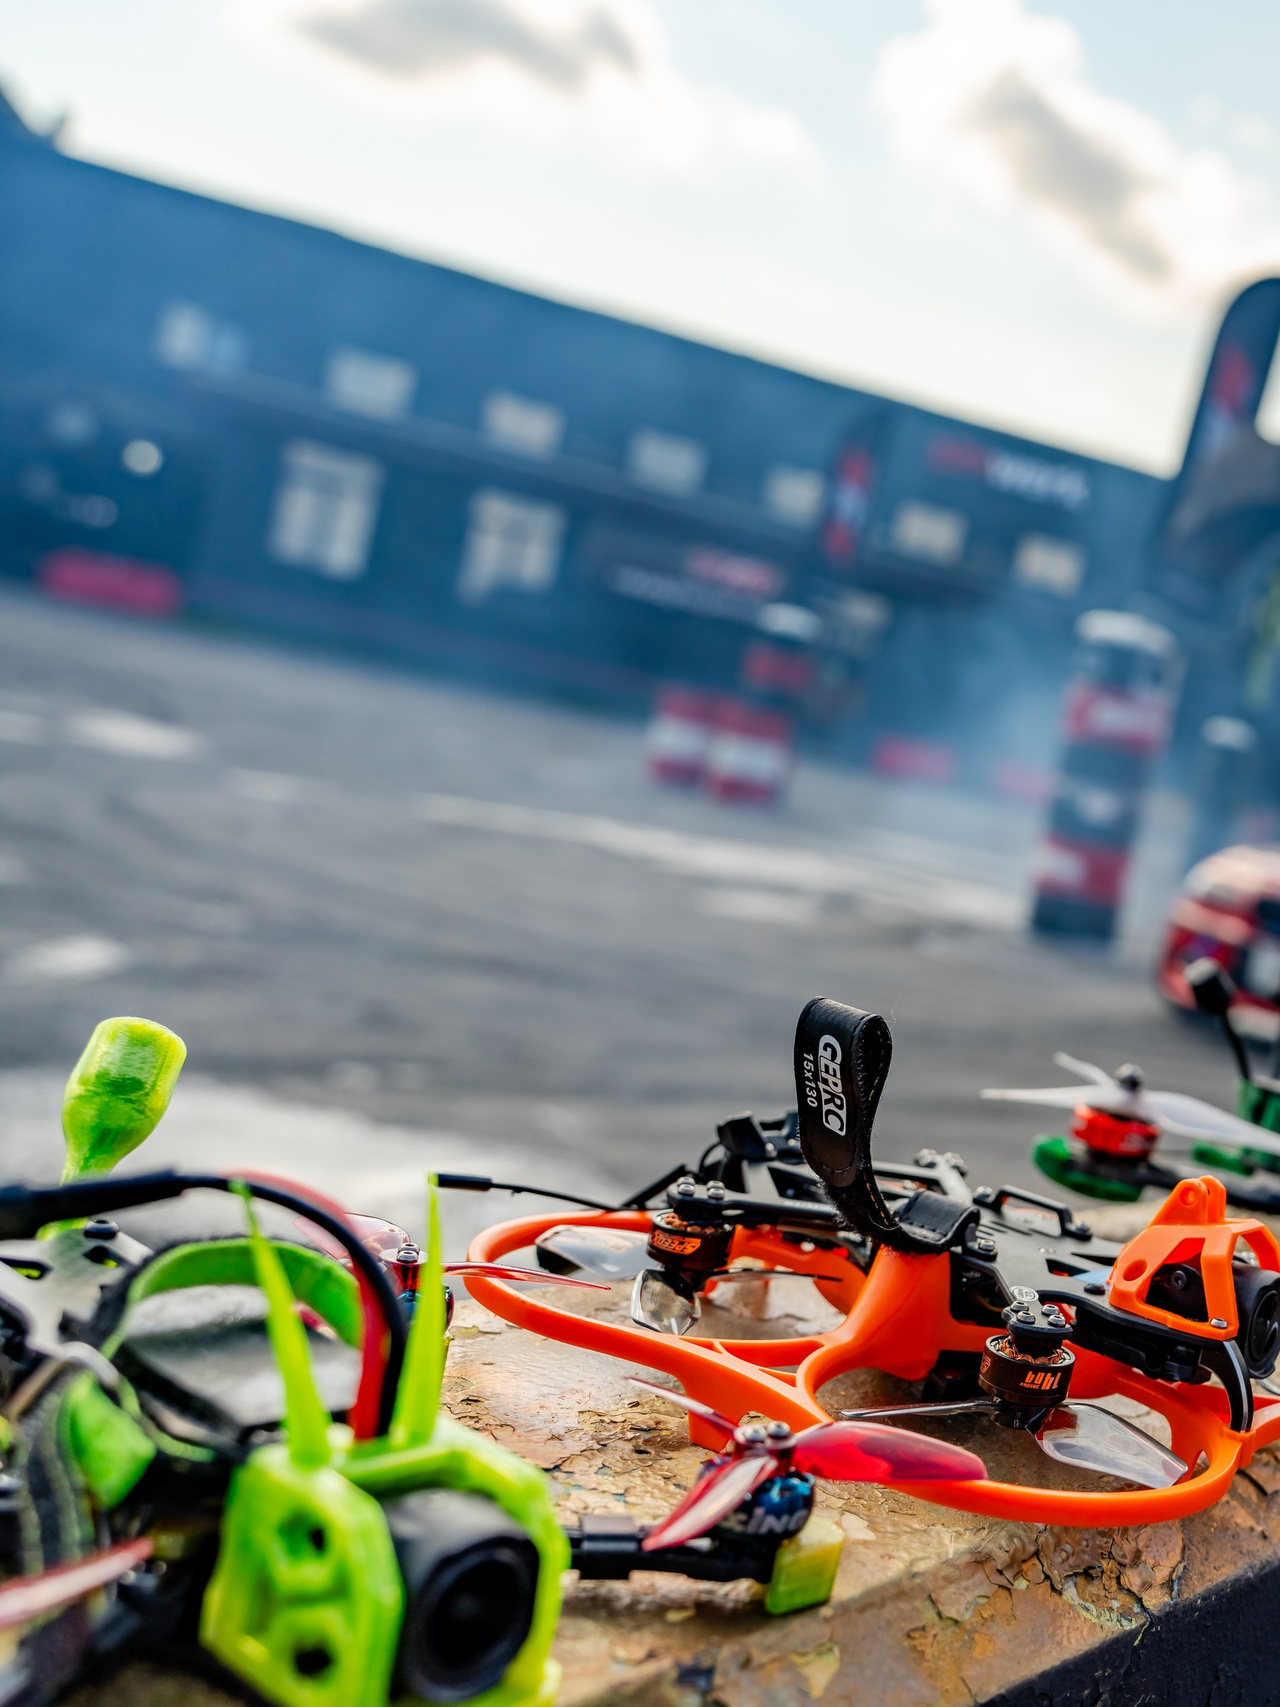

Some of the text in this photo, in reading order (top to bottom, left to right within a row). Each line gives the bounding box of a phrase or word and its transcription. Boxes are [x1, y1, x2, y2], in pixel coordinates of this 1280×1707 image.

[803, 1053, 818, 1107] 15x130
[818, 1034, 847, 1136] GEPRC
[1025, 1371, 1061, 1390] 1404
